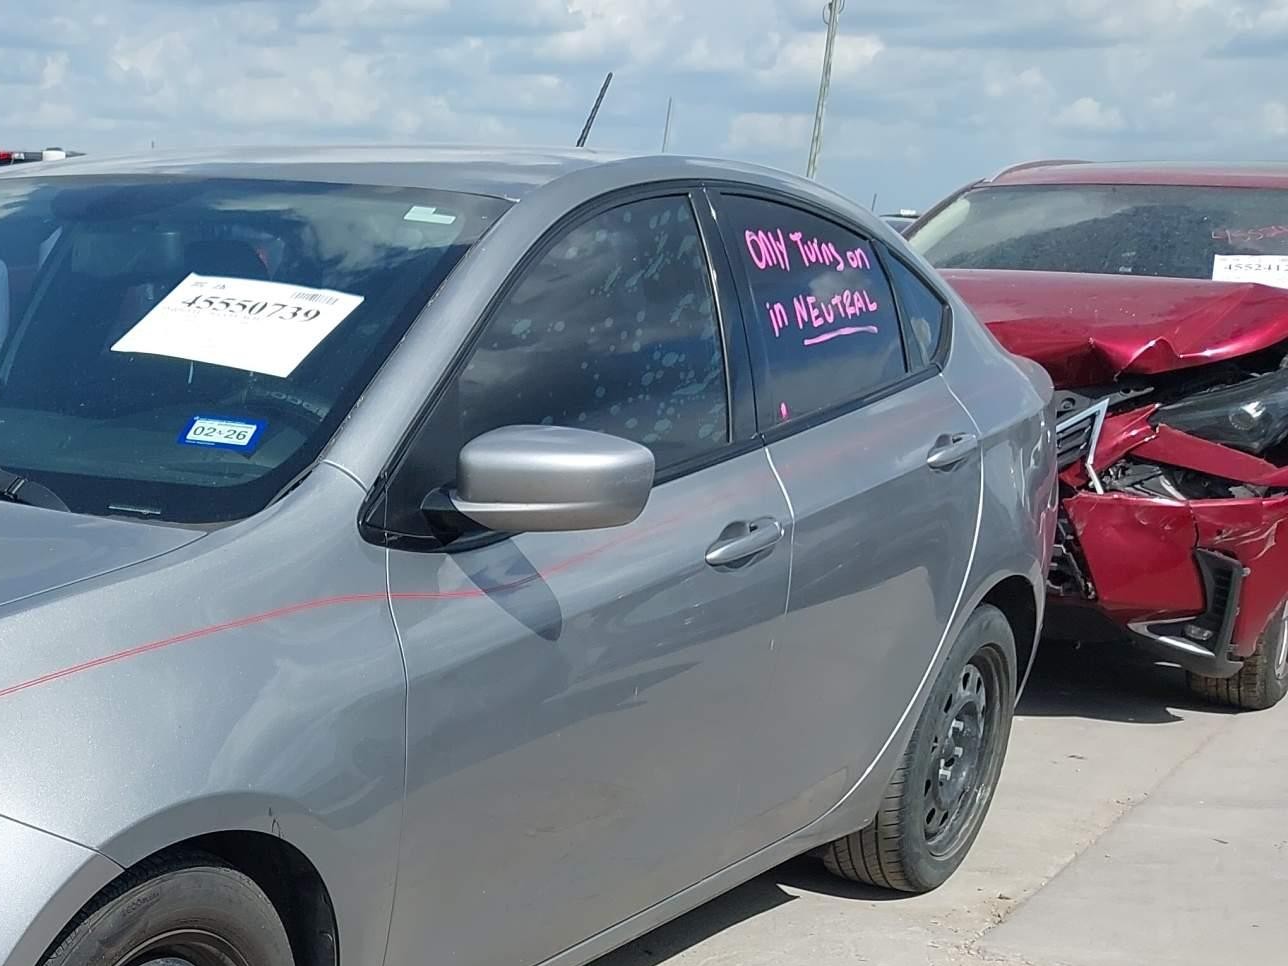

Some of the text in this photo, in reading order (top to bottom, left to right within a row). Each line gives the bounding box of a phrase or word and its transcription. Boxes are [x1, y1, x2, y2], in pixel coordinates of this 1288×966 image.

[789, 231, 845, 272] Turns
[846, 247, 871, 270] on
[181, 293, 321, 322] 45550739
[766, 289, 878, 337] in NEUTRAL
